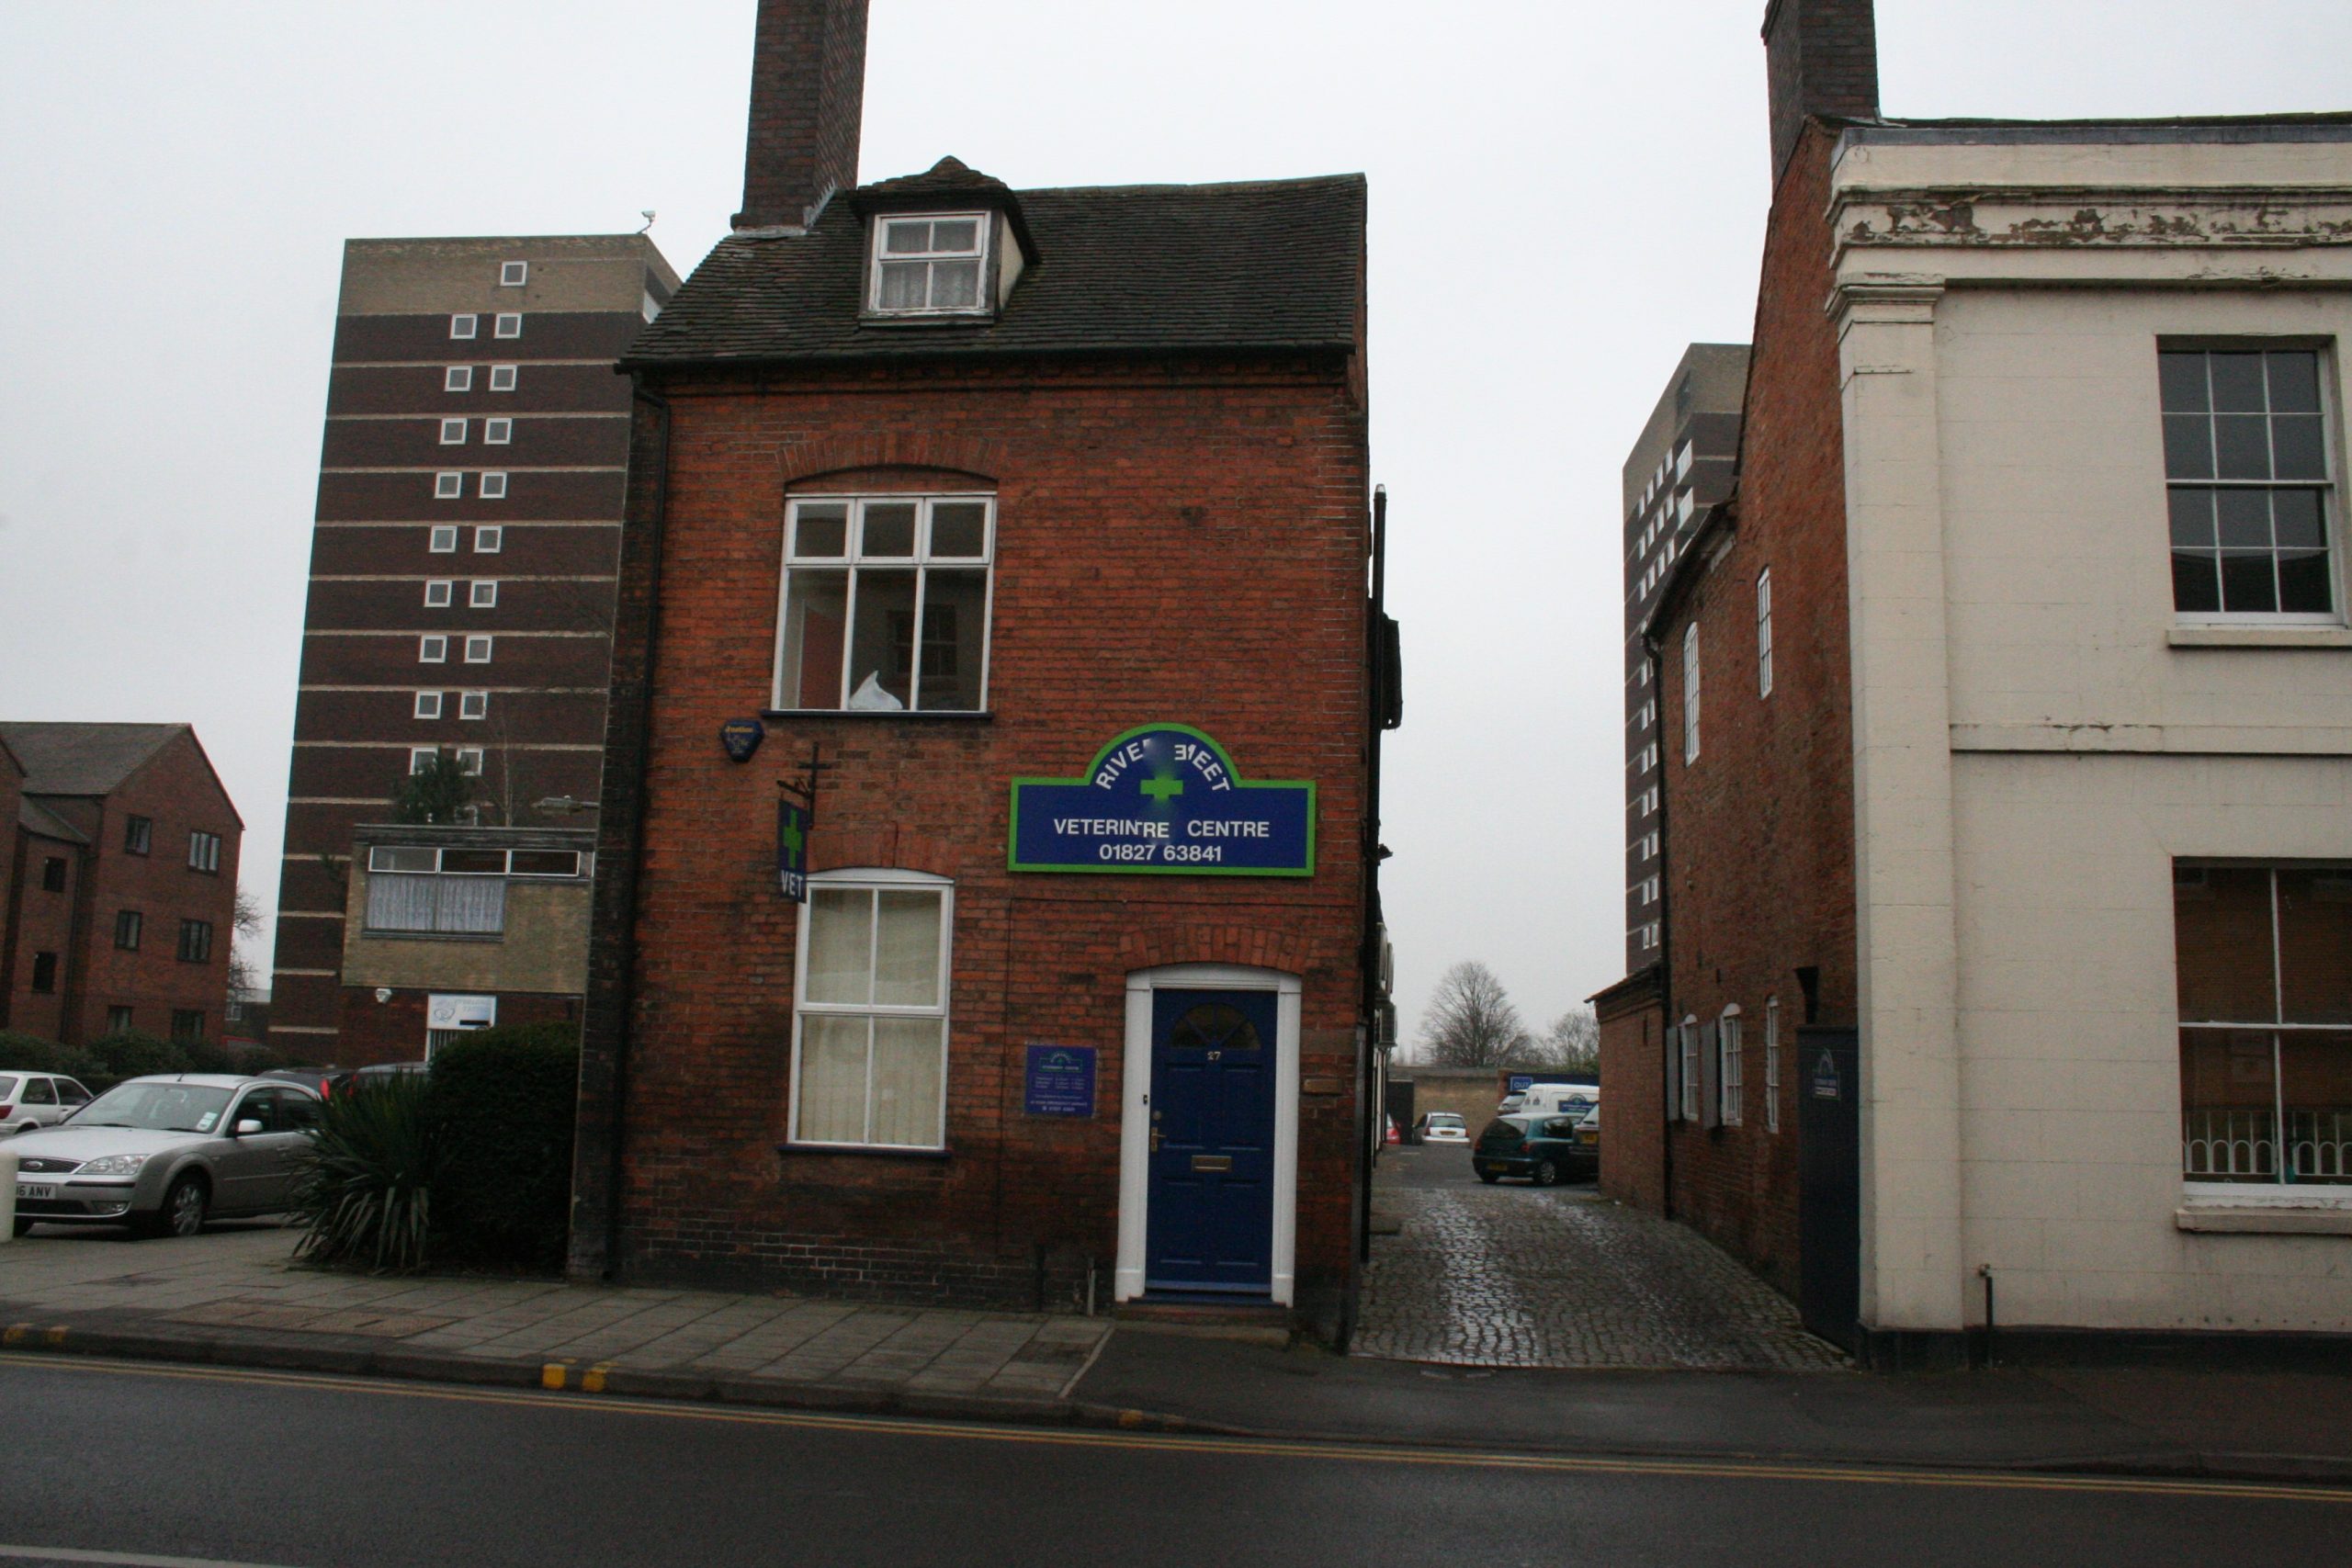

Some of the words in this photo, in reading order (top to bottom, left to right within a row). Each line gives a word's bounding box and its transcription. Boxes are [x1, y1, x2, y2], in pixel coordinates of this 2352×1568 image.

[1187, 820, 1270, 838] CENTRE
[1099, 844, 1156, 861] 01827
[1163, 844, 1222, 862] 63841
[781, 869, 803, 897] VET
[1207, 1051, 1221, 1061] 27
[29, 1186, 51, 1198] ANV
